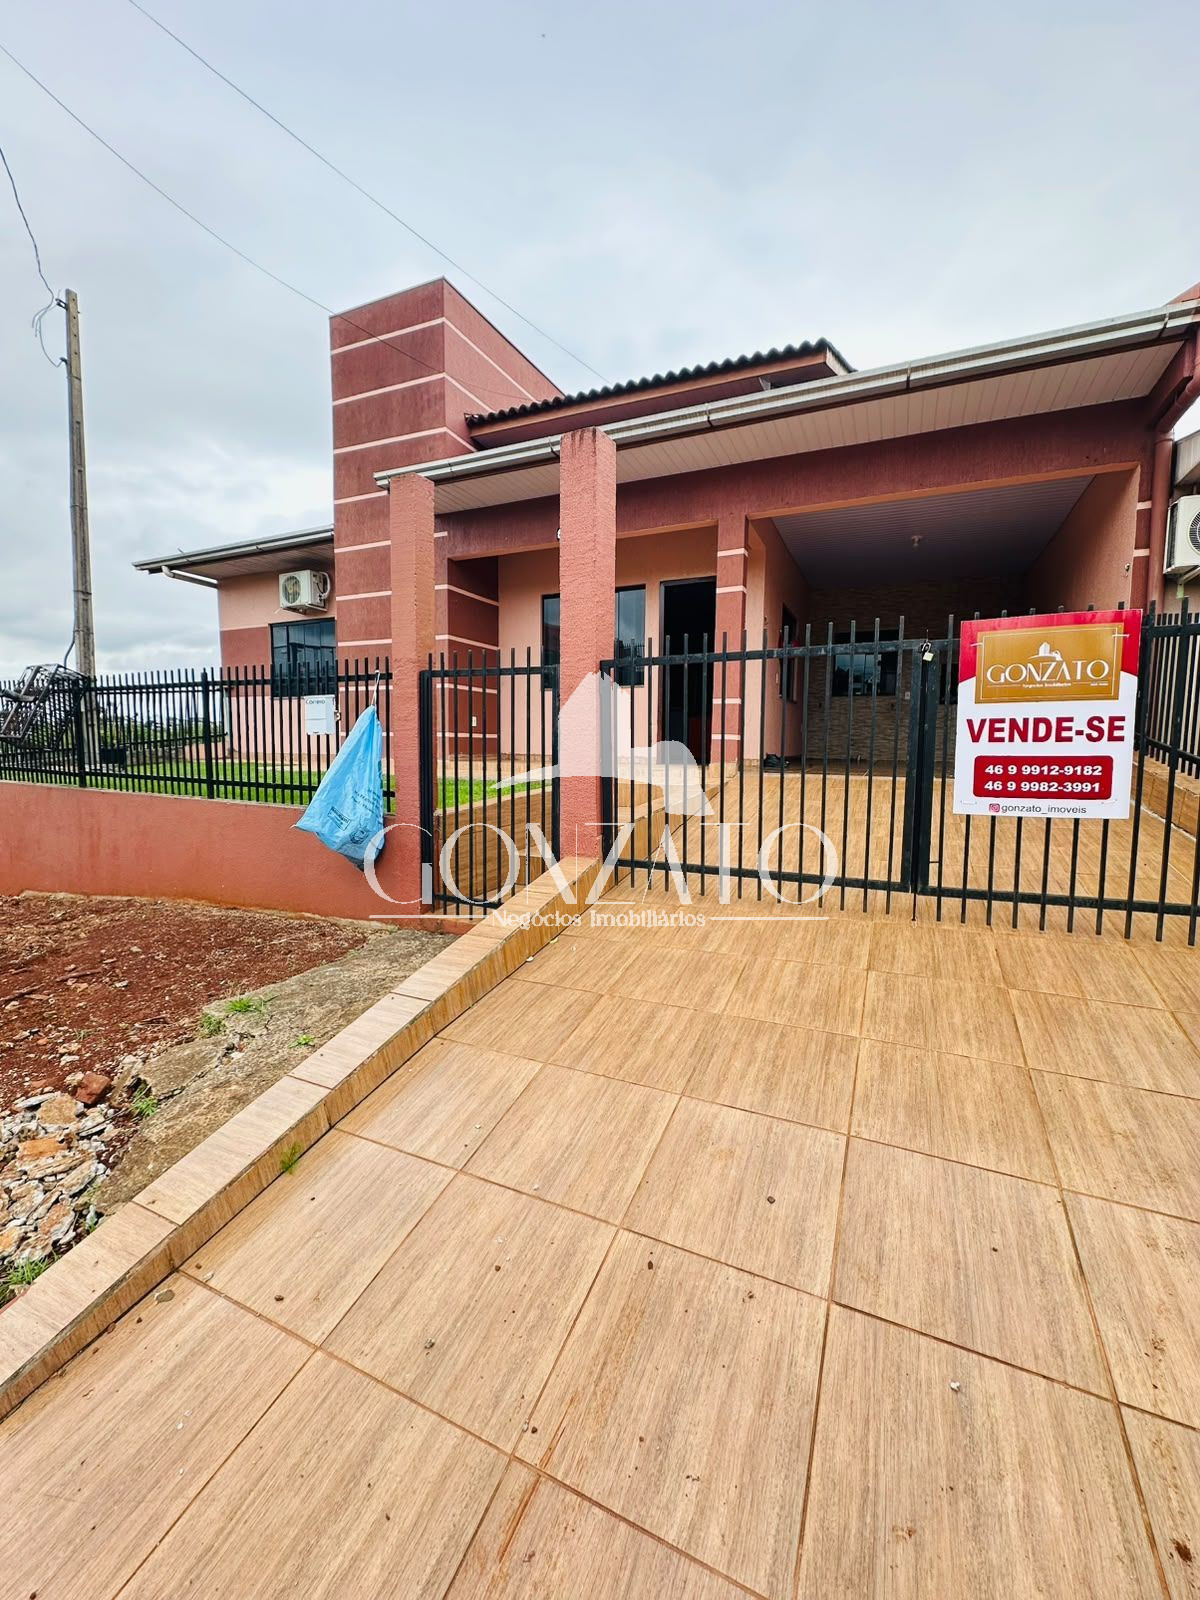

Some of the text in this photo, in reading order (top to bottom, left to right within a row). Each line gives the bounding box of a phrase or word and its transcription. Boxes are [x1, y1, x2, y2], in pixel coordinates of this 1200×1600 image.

[986, 659, 1110, 684] GONZATO
[966, 715, 1126, 743] VENDE-SE
[984, 764, 1103, 776] 46 9 9912-9182
[983, 780, 1100, 793] 46 9 9982-3991
[1001, 804, 1087, 815] gonzato_imoveis
